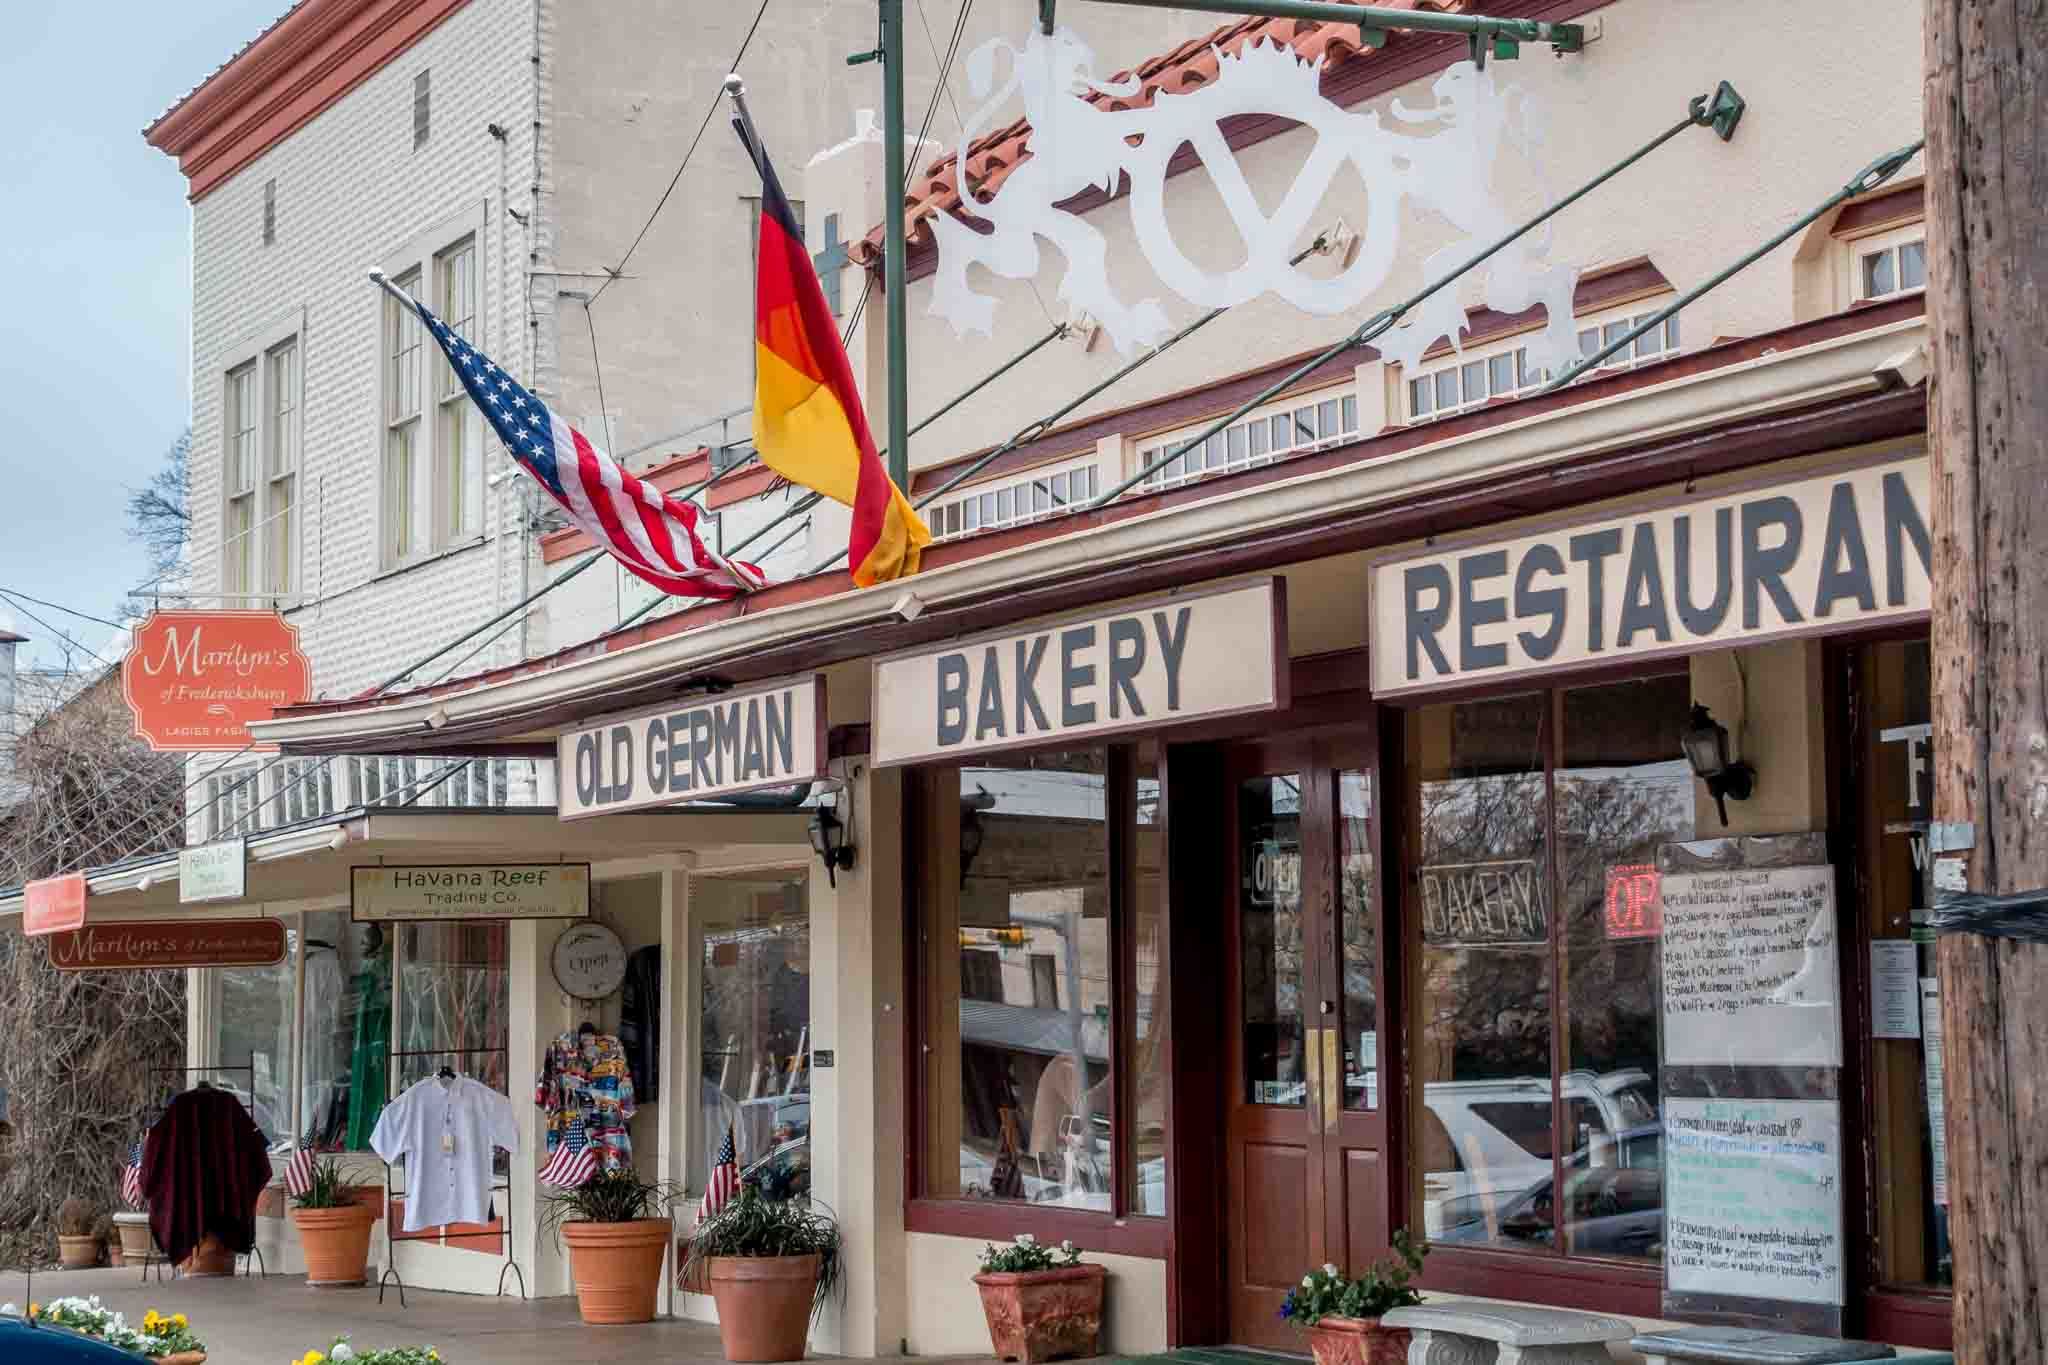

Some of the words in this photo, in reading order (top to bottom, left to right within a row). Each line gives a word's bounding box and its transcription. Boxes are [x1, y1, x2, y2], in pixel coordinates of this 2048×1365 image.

[1403, 470, 1932, 680] RESTAURAN
[143, 625, 290, 676] Marilyn's
[936, 606, 1191, 746] BAKERY
[176, 684, 288, 704] Fredericksburg
[575, 724, 635, 806] OLD
[645, 691, 794, 794] GERMAN
[393, 870, 482, 888] Havana
[487, 869, 549, 887] Reef
[423, 891, 488, 905] Trading
[492, 890, 521, 904] Co.
[1608, 872, 1657, 928] OP
[59, 927, 177, 963] Marilyn's
